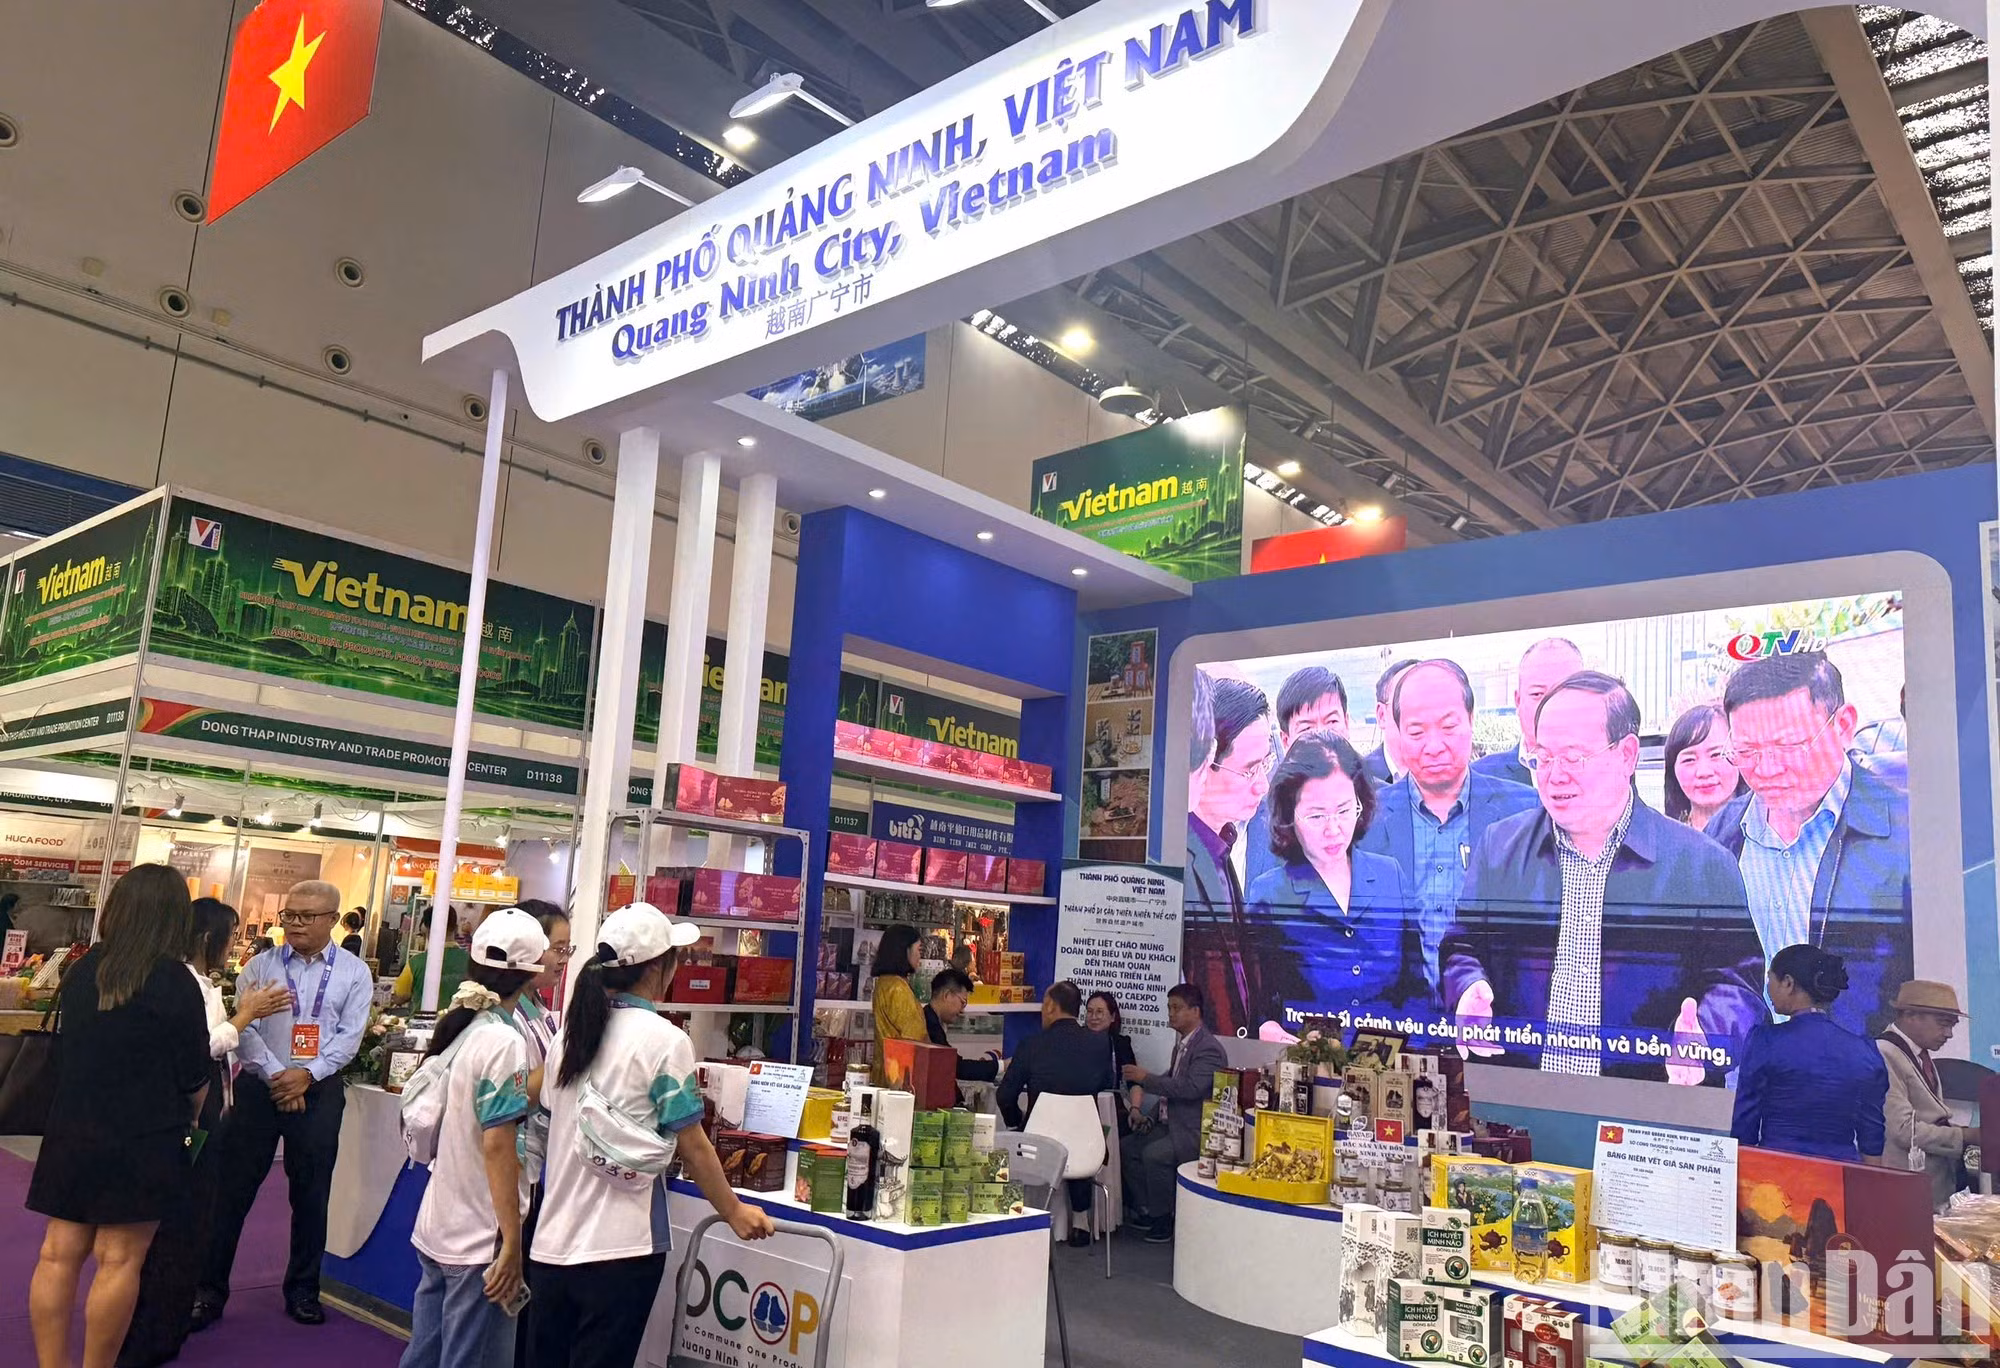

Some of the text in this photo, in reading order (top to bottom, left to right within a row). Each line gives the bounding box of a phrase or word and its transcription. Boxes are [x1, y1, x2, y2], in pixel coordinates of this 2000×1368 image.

[556, 270, 646, 341] THÀNH
[655, 224, 721, 298] PHỐ
[727, 173, 855, 263] QUẢNG
[1003, 51, 1110, 138] VIỆT
[1124, 0, 1255, 90] NAM
[612, 128, 1117, 360] Quang Ninh City, Vietnam
[765, 273, 874, 339] 越南广宁市
[1060, 475, 1178, 522] Vietnam
[37, 556, 105, 605] Vietnam
[272, 557, 468, 633] Vietnam
[201, 719, 239, 735] DONG
[241, 726, 275, 741] THAP
[276, 732, 337, 751] INDUSTRY
[338, 742, 363, 755] AND
[365, 745, 401, 761] TRADE
[467, 761, 507, 777] CENTER
[527, 769, 562, 784] D11138
[928, 716, 1018, 759] Vietnam
[5, 834, 34, 844] HUCA
[834, 816, 859, 828] D11137
[1072, 968, 1093, 976] GIAN
[1102, 960, 1126, 969] THAM
[1125, 992, 1157, 1002] CAEXPO
[1139, 1004, 1160, 1013] 2026
[1427, 1016, 1458, 1038] cầu
[1462, 1024, 1500, 1042] phát
[1547, 1031, 1602, 1051] nhanh
[1606, 1035, 1630, 1054] và
[1440, 1231, 1462, 1240] HUYẾT
[1416, 1306, 1436, 1314] HUYẾT
[694, 1324, 767, 1360] Commune One
[715, 1349, 739, 1367] Ninh
